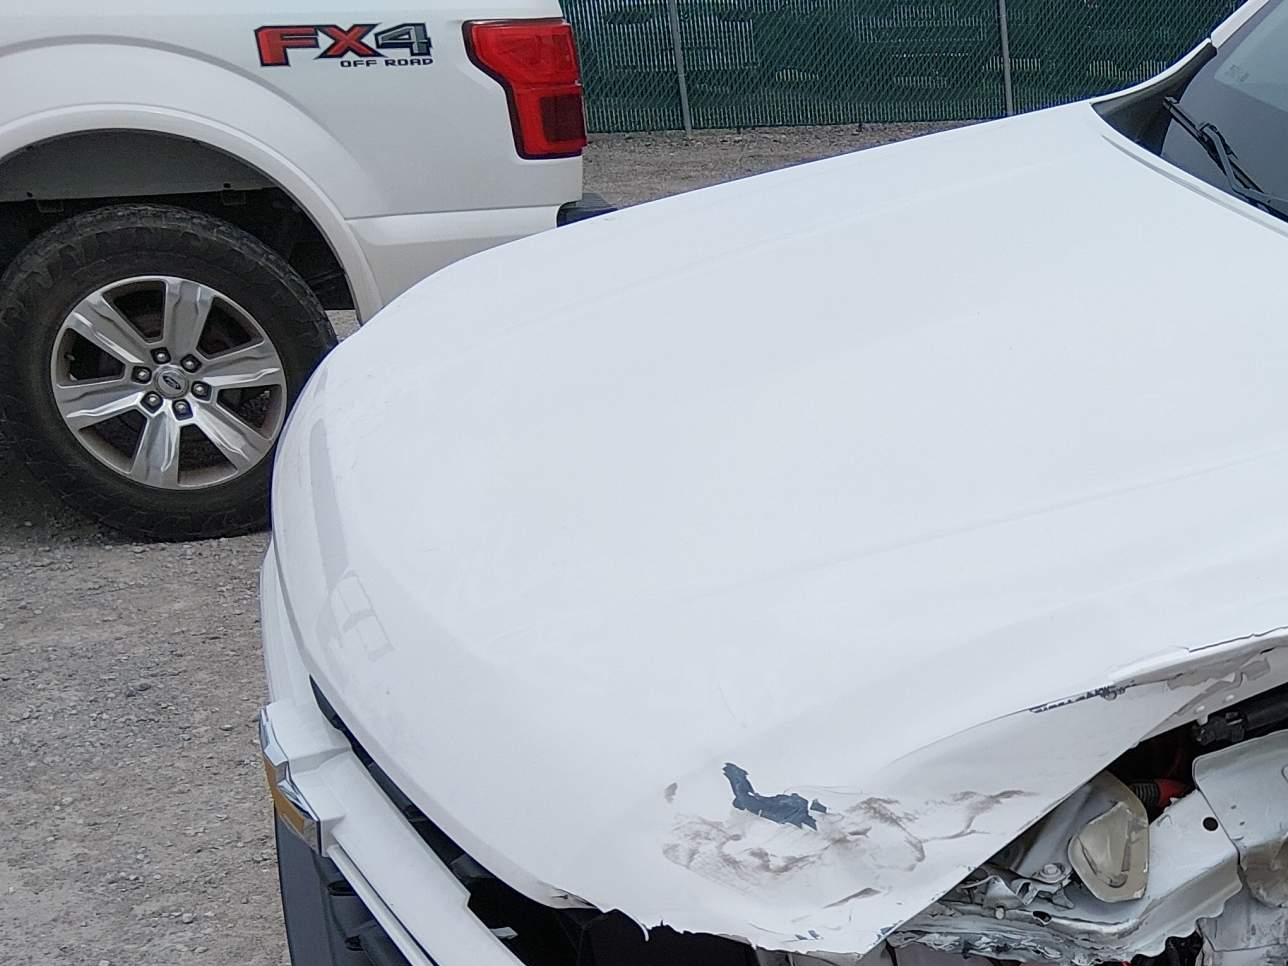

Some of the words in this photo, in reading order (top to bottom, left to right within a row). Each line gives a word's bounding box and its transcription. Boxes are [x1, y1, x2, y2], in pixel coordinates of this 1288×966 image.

[254, 22, 433, 67] FX4
[340, 59, 378, 68] OFF
[384, 58, 434, 67] ROAD
